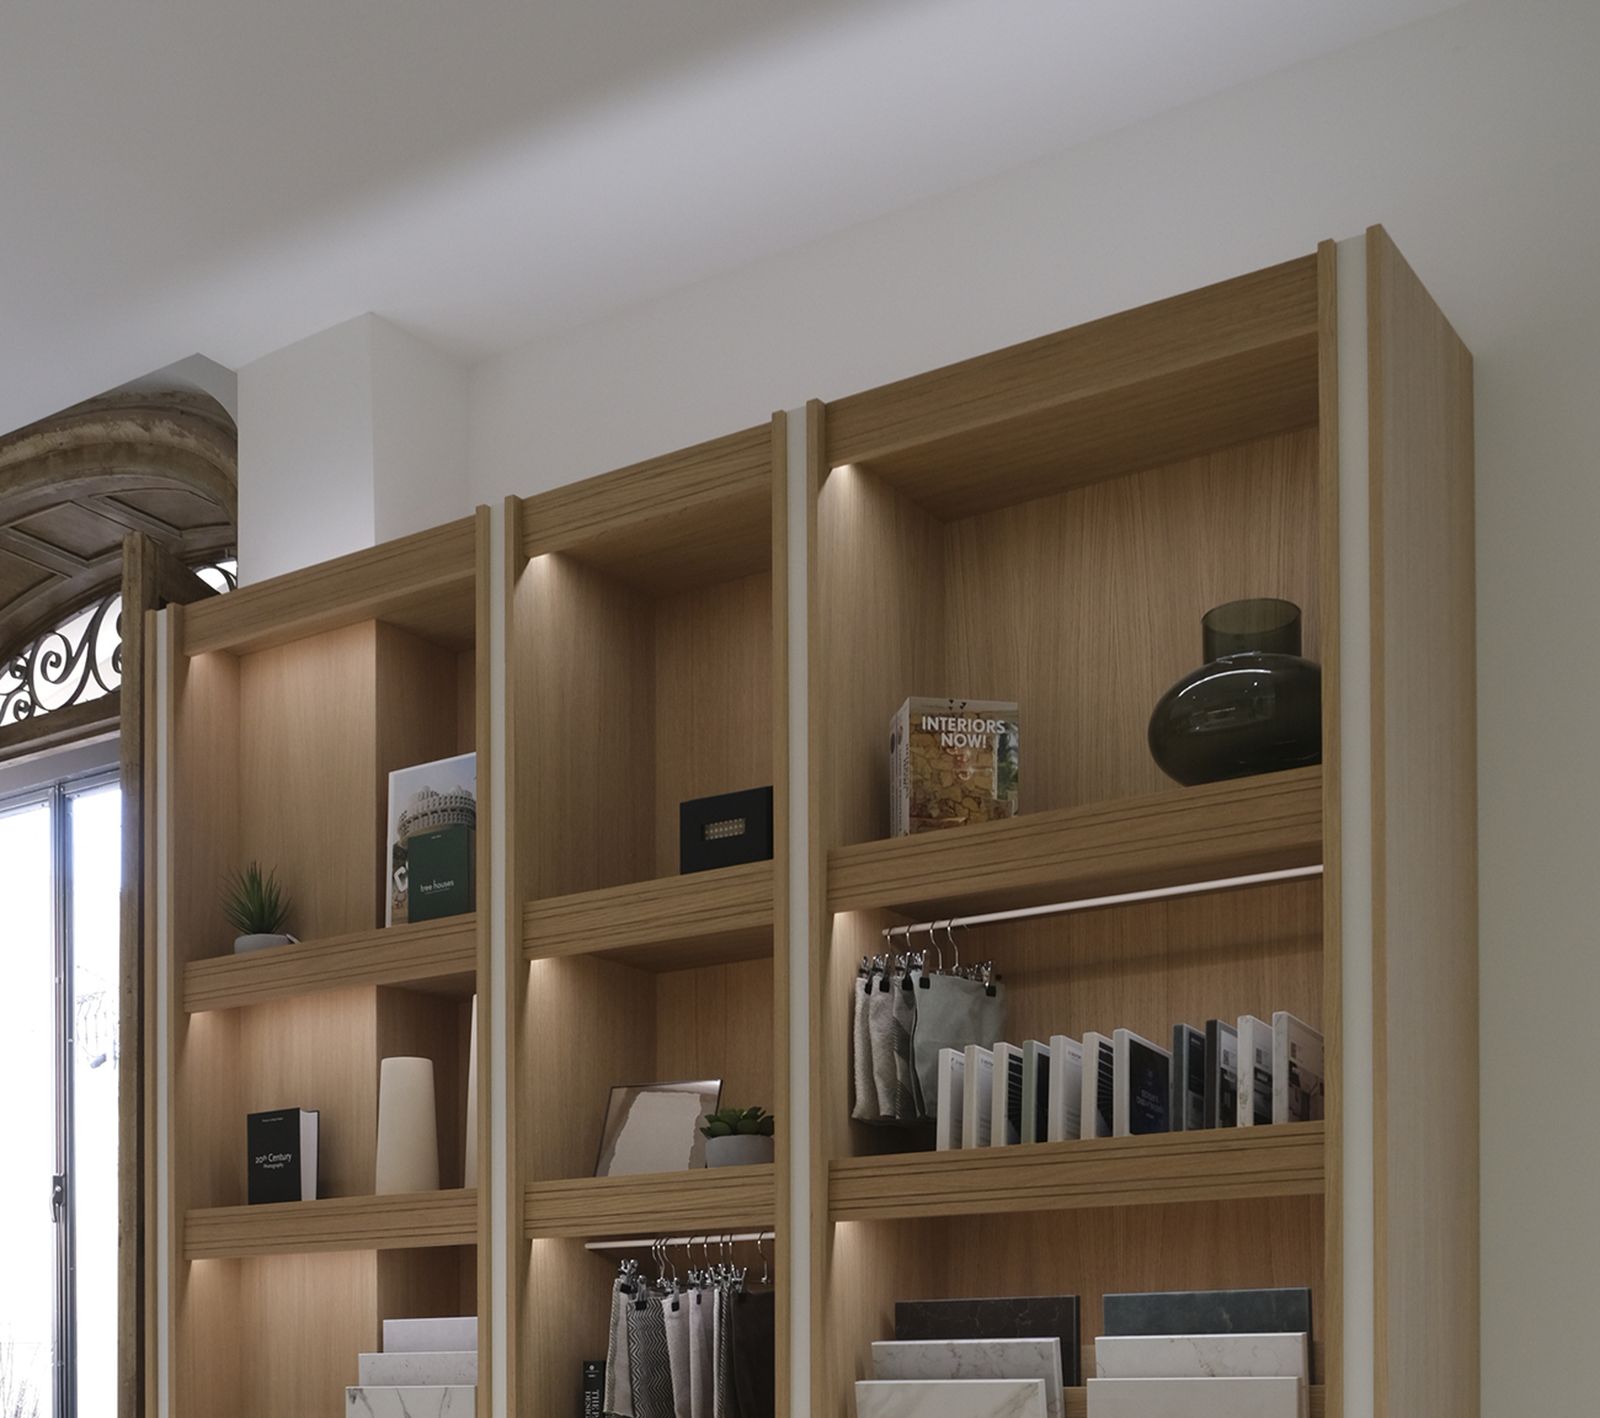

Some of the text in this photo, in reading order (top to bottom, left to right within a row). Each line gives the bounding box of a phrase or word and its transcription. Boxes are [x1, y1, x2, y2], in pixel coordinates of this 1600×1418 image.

[922, 716, 1006, 734] INTERIORS
[941, 733, 987, 749] NOW!
[268, 1153, 292, 1163] Century
